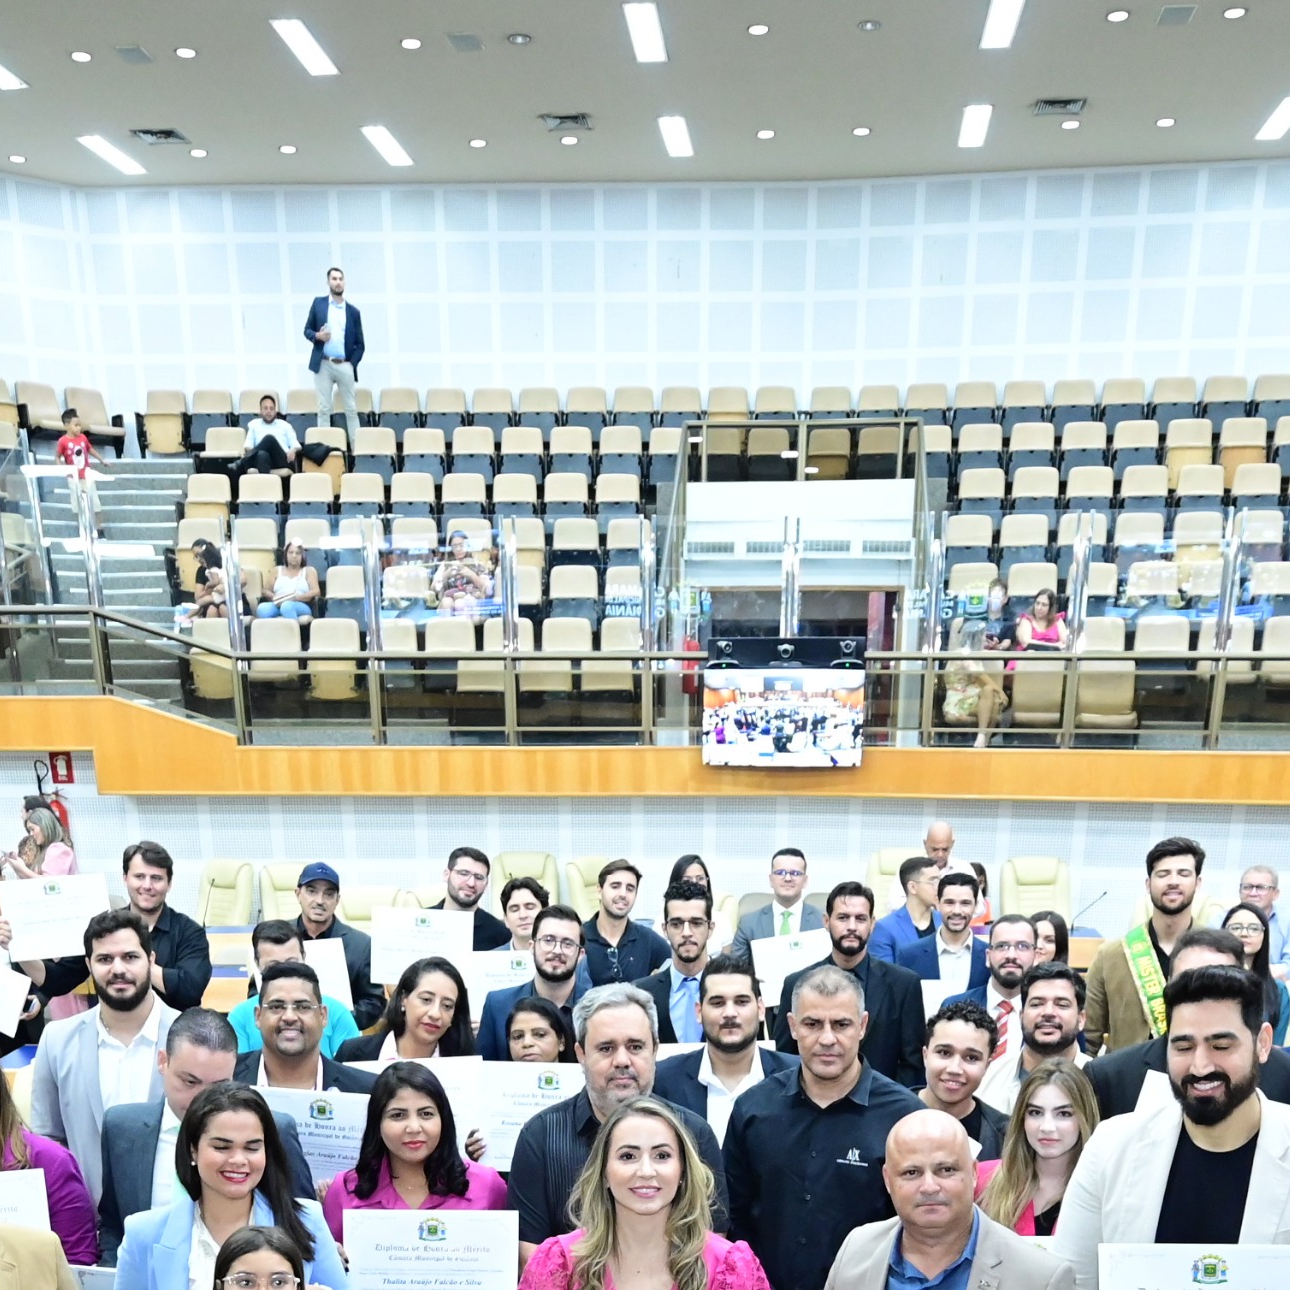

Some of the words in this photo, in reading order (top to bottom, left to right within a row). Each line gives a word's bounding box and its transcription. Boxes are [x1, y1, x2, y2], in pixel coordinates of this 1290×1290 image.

[1136, 956, 1161, 995] MISTER
[375, 1243, 409, 1253] Diploma
[409, 1278, 432, 1287] Araújo
[434, 1278, 458, 1286] Falcão
